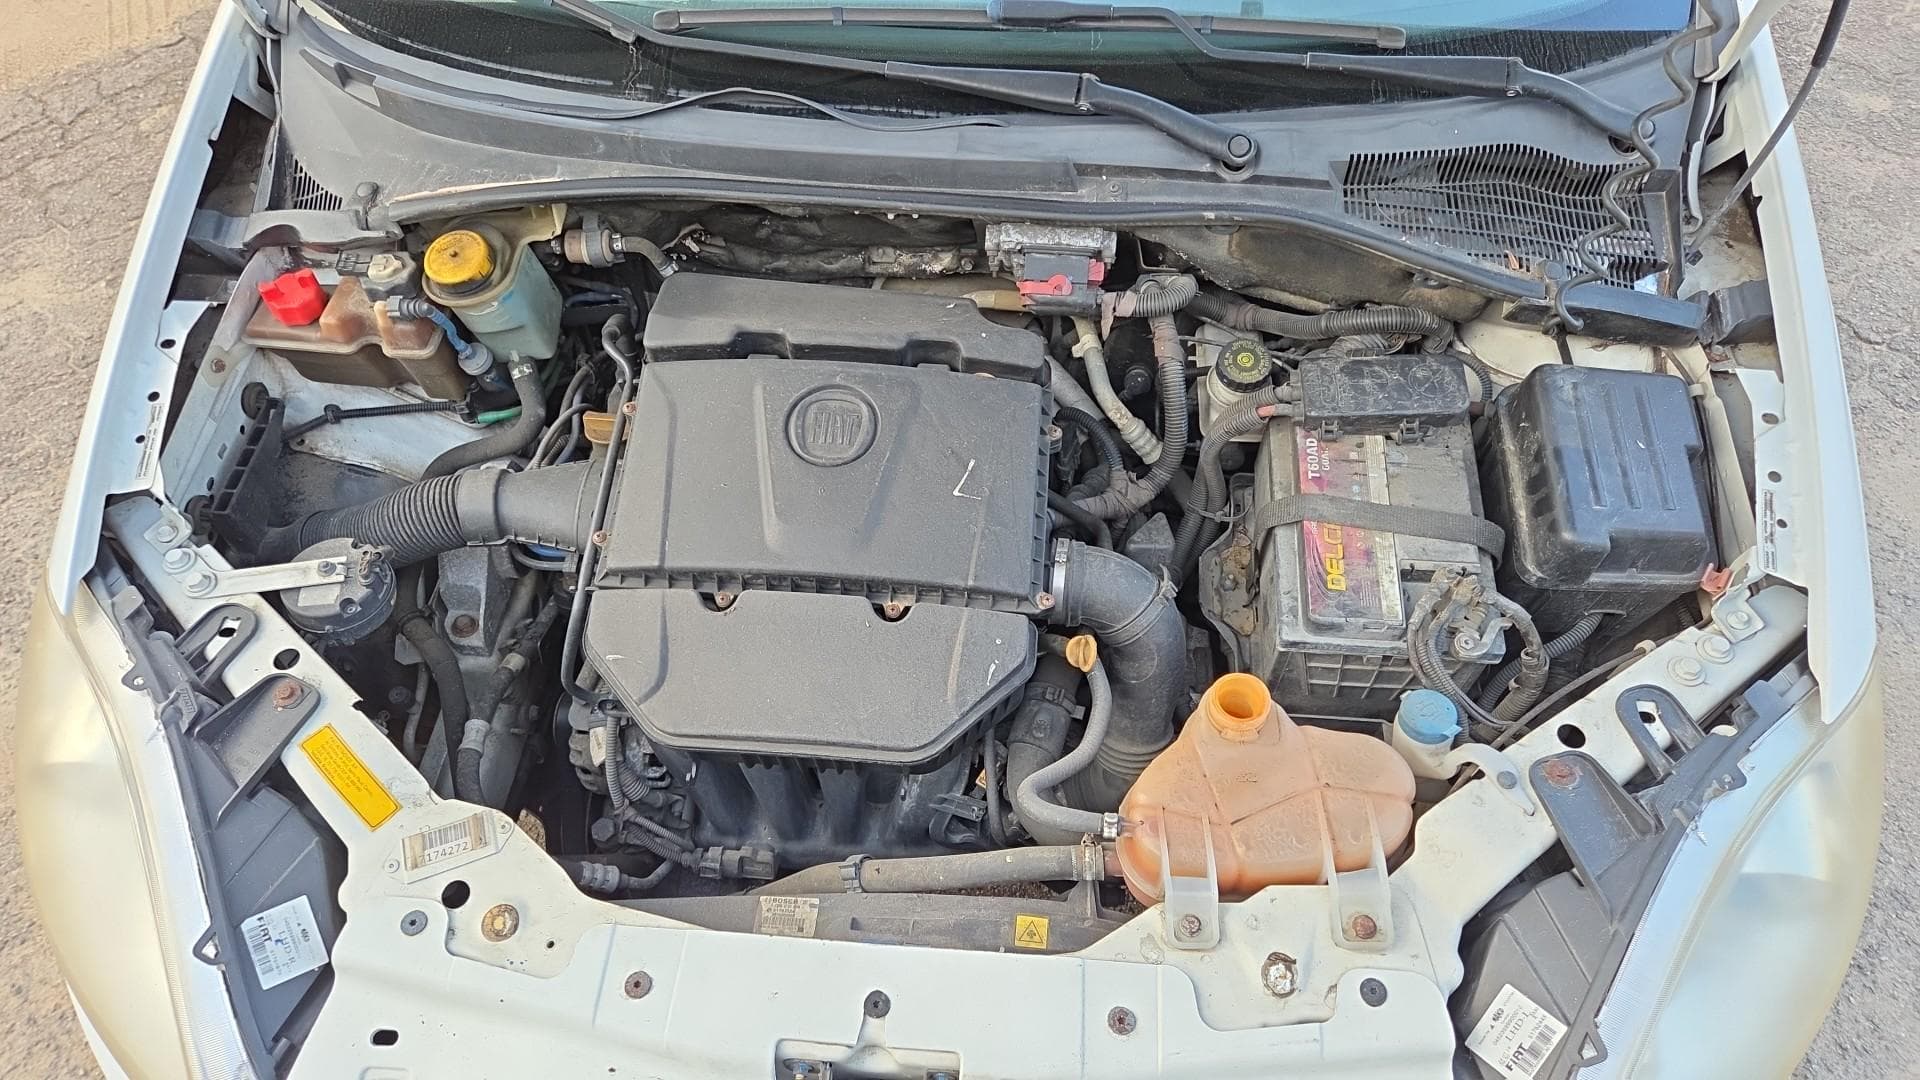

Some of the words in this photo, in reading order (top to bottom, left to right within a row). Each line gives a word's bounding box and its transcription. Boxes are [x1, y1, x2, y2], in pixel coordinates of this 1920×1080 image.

[808, 408, 862, 446] FIAT
[1306, 438, 1320, 479] T60AD
[257, 916, 273, 943] FIAT
[1505, 1042, 1529, 1072] FIAT
